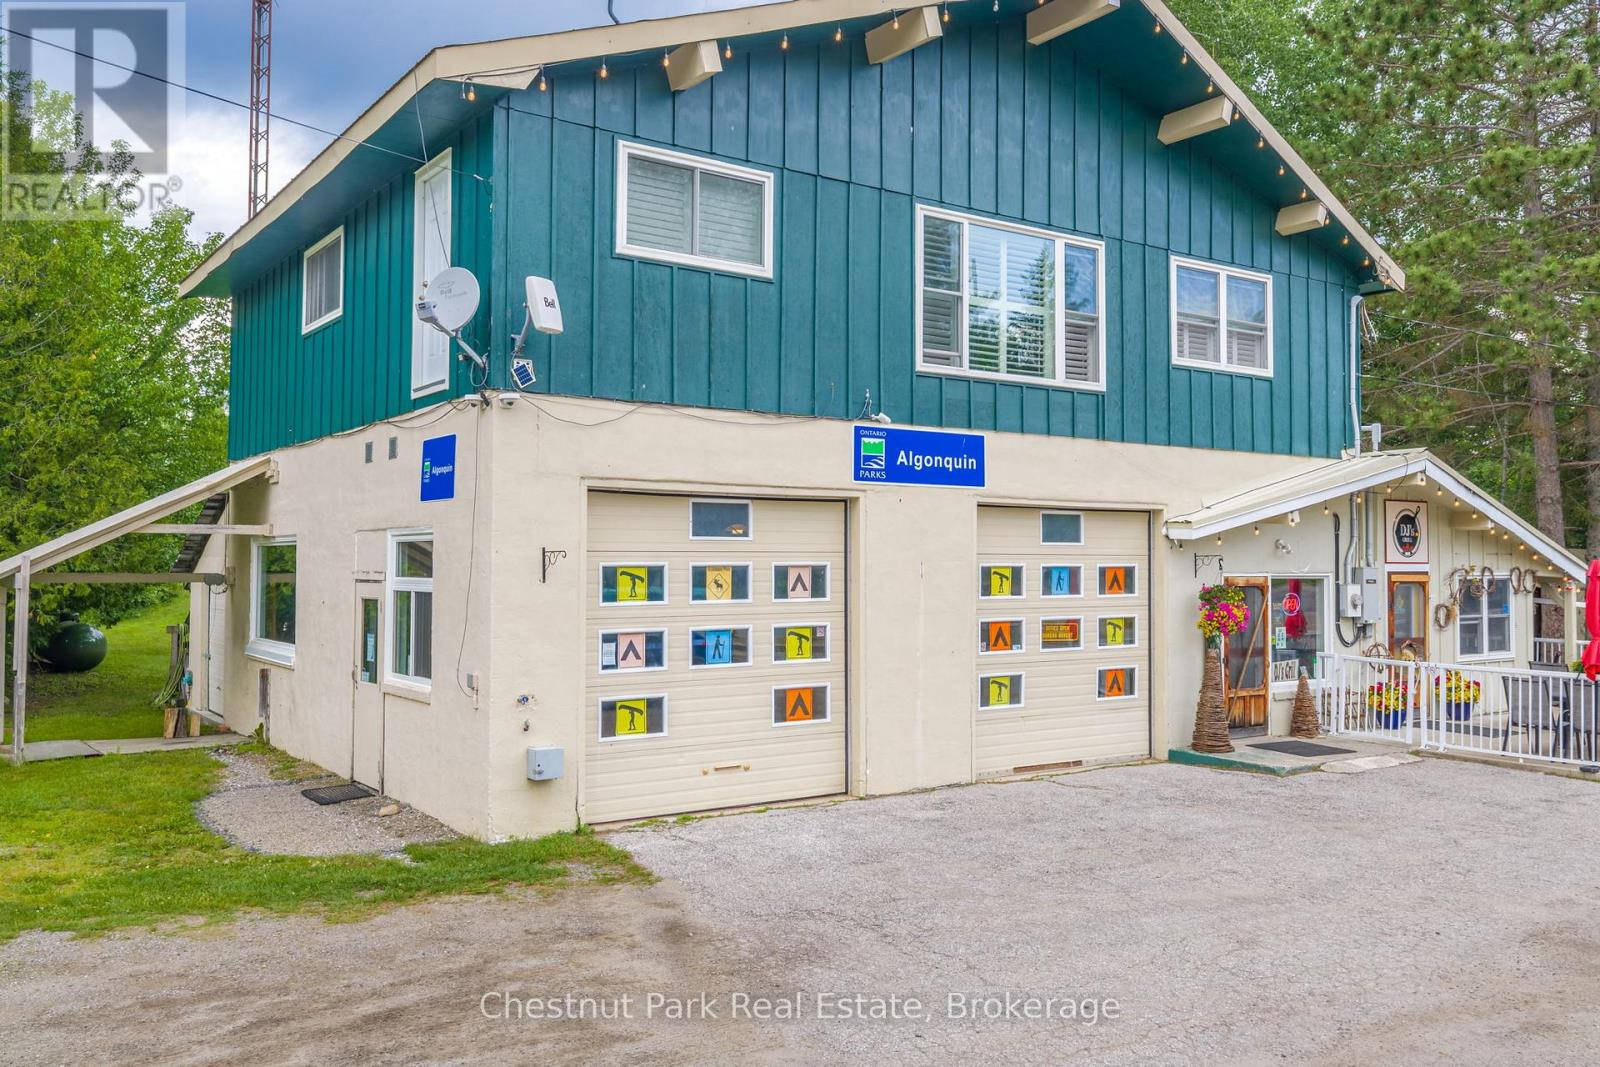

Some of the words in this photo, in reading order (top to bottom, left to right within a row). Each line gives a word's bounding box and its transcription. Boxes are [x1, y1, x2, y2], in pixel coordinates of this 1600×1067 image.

[544, 297, 557, 309] Bell
[860, 429, 887, 437] ONTARIO
[896, 450, 977, 472] Algonquin
[432, 464, 453, 476] Algonquin
[860, 470, 886, 479] PARKS
[1400, 524, 1415, 537] DJ's
